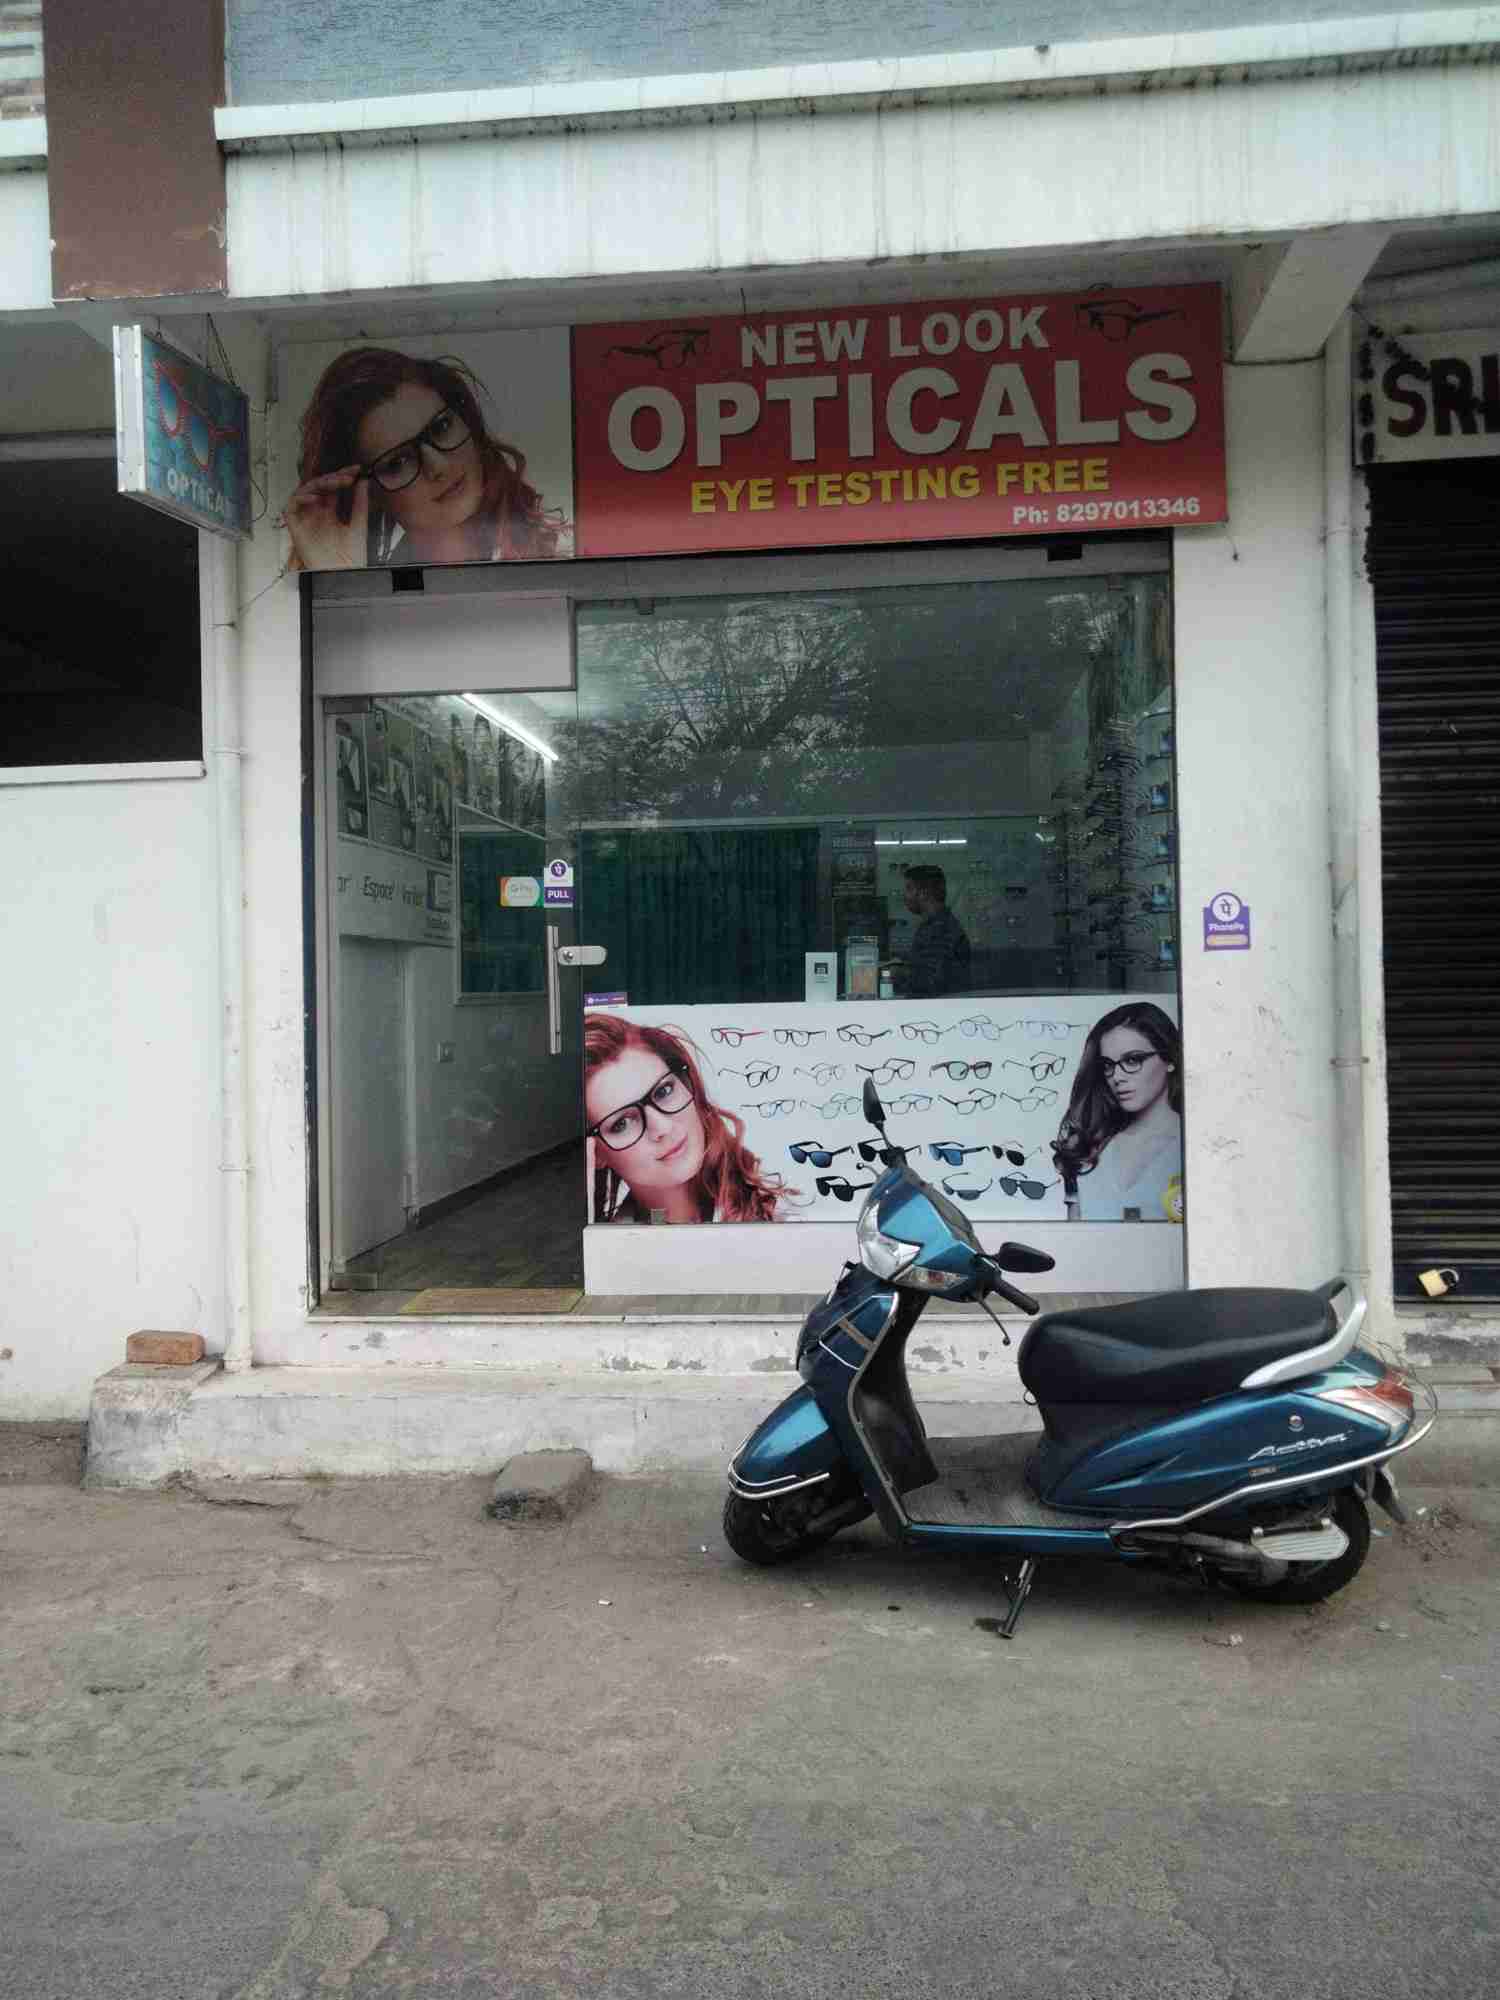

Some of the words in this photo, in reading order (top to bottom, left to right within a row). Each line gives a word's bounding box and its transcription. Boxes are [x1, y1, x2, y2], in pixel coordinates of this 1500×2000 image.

[741, 319, 869, 368] NEW
[887, 305, 1051, 358] LOOK
[607, 352, 1198, 473] OPTICALS
[691, 478, 775, 513] EYE
[788, 465, 981, 508] TESTING
[996, 458, 1110, 495] FREE
[1012, 504, 1050, 525] Ph:
[1056, 497, 1201, 523] 8297013346
[547, 889, 570, 899] PULL
